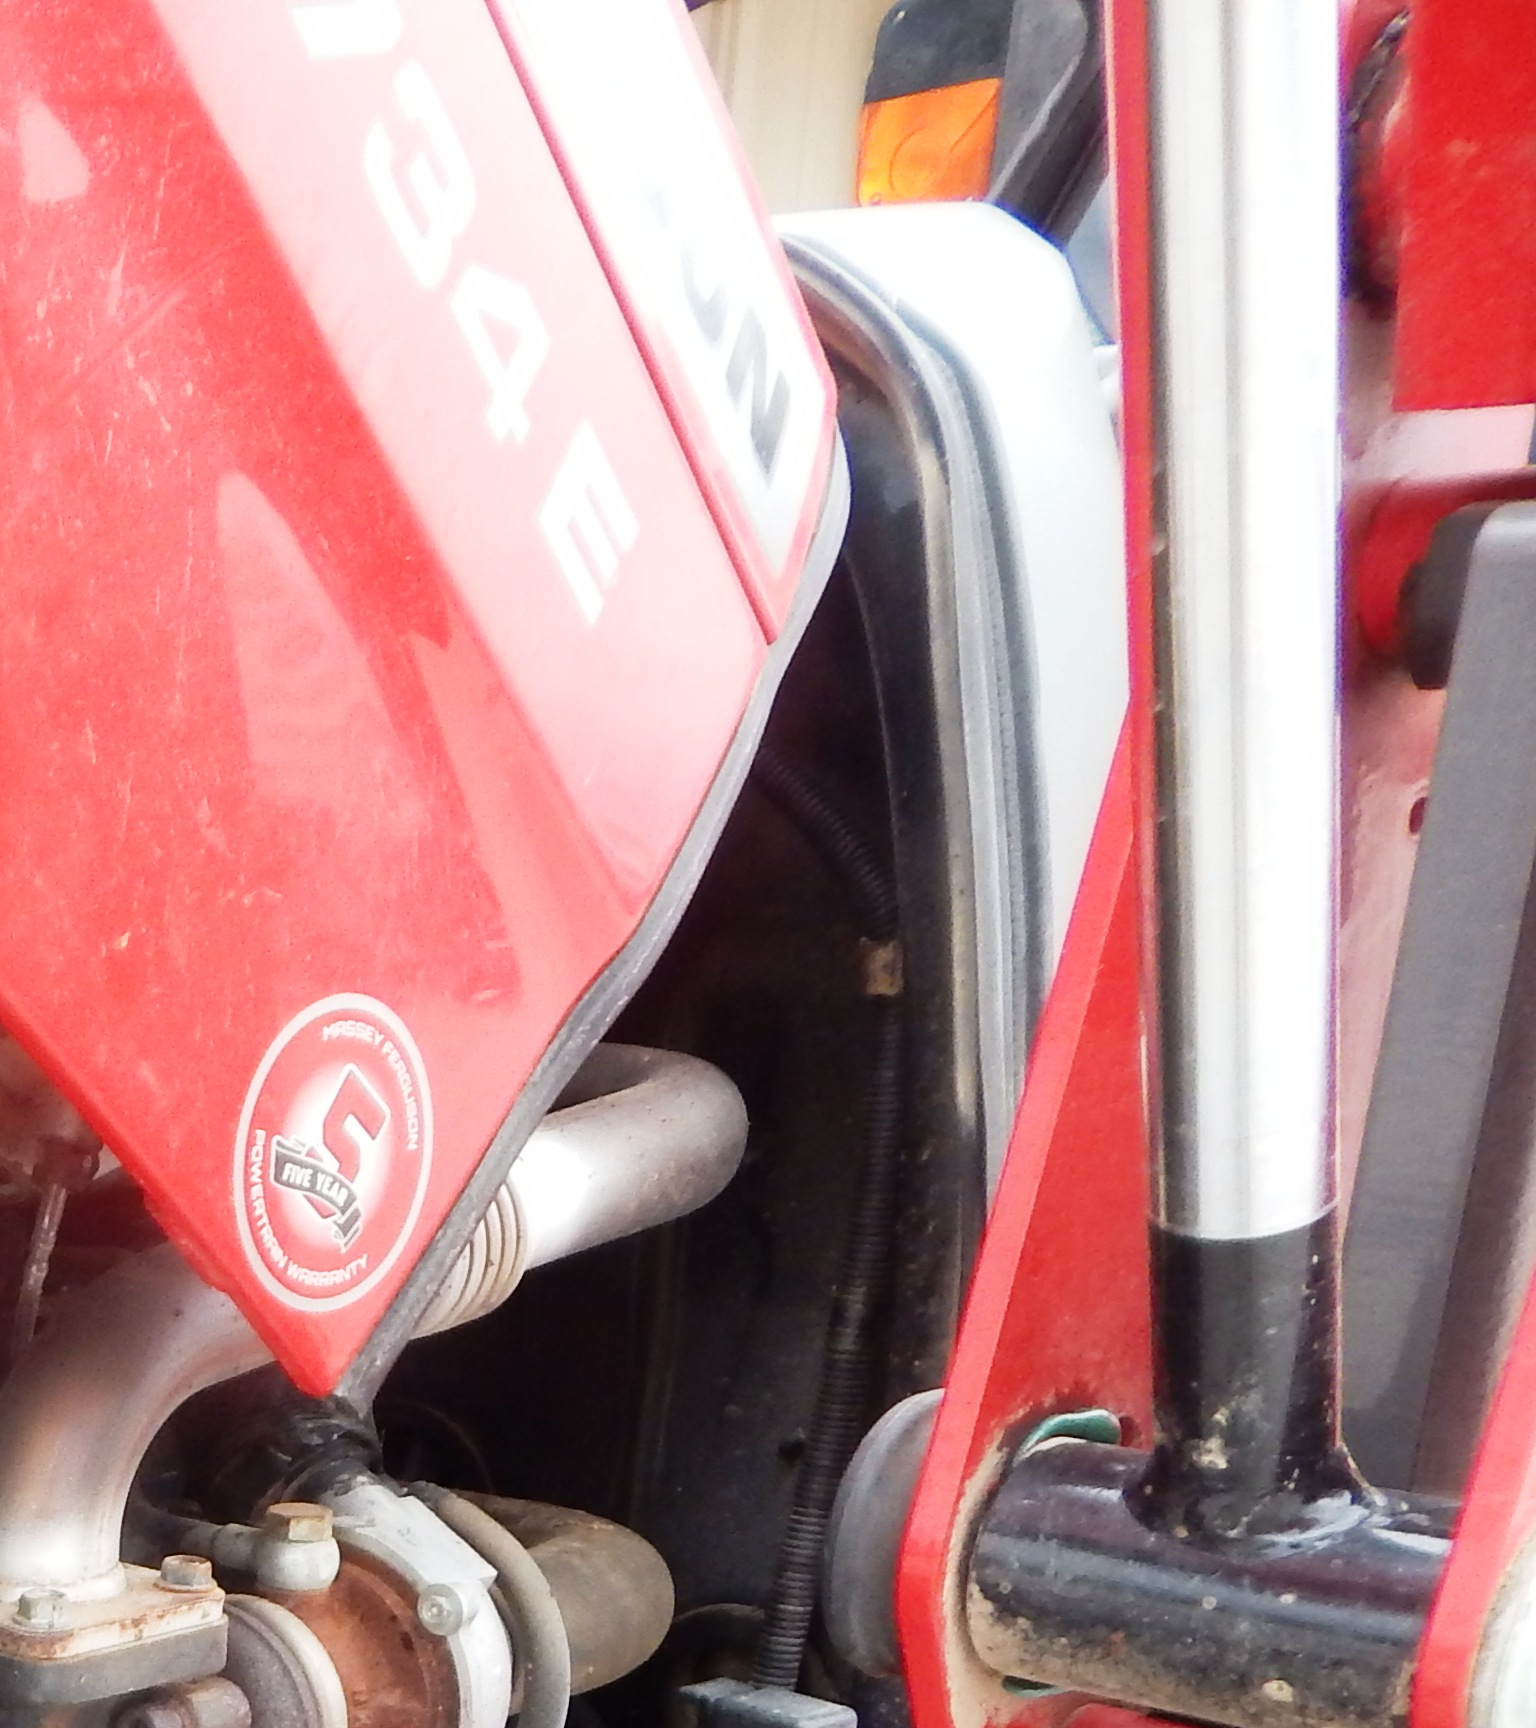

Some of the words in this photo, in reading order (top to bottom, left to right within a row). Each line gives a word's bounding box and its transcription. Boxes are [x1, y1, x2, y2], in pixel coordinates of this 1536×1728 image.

[323, 1020, 384, 1046] MASSEY
[381, 1041, 419, 1150] FERGUSON
[249, 1129, 288, 1268] POWERTRAIN
[286, 1254, 368, 1286] WARRANTY
[283, 1162, 313, 1189] FIVE
[316, 1173, 348, 1206] YEAR
